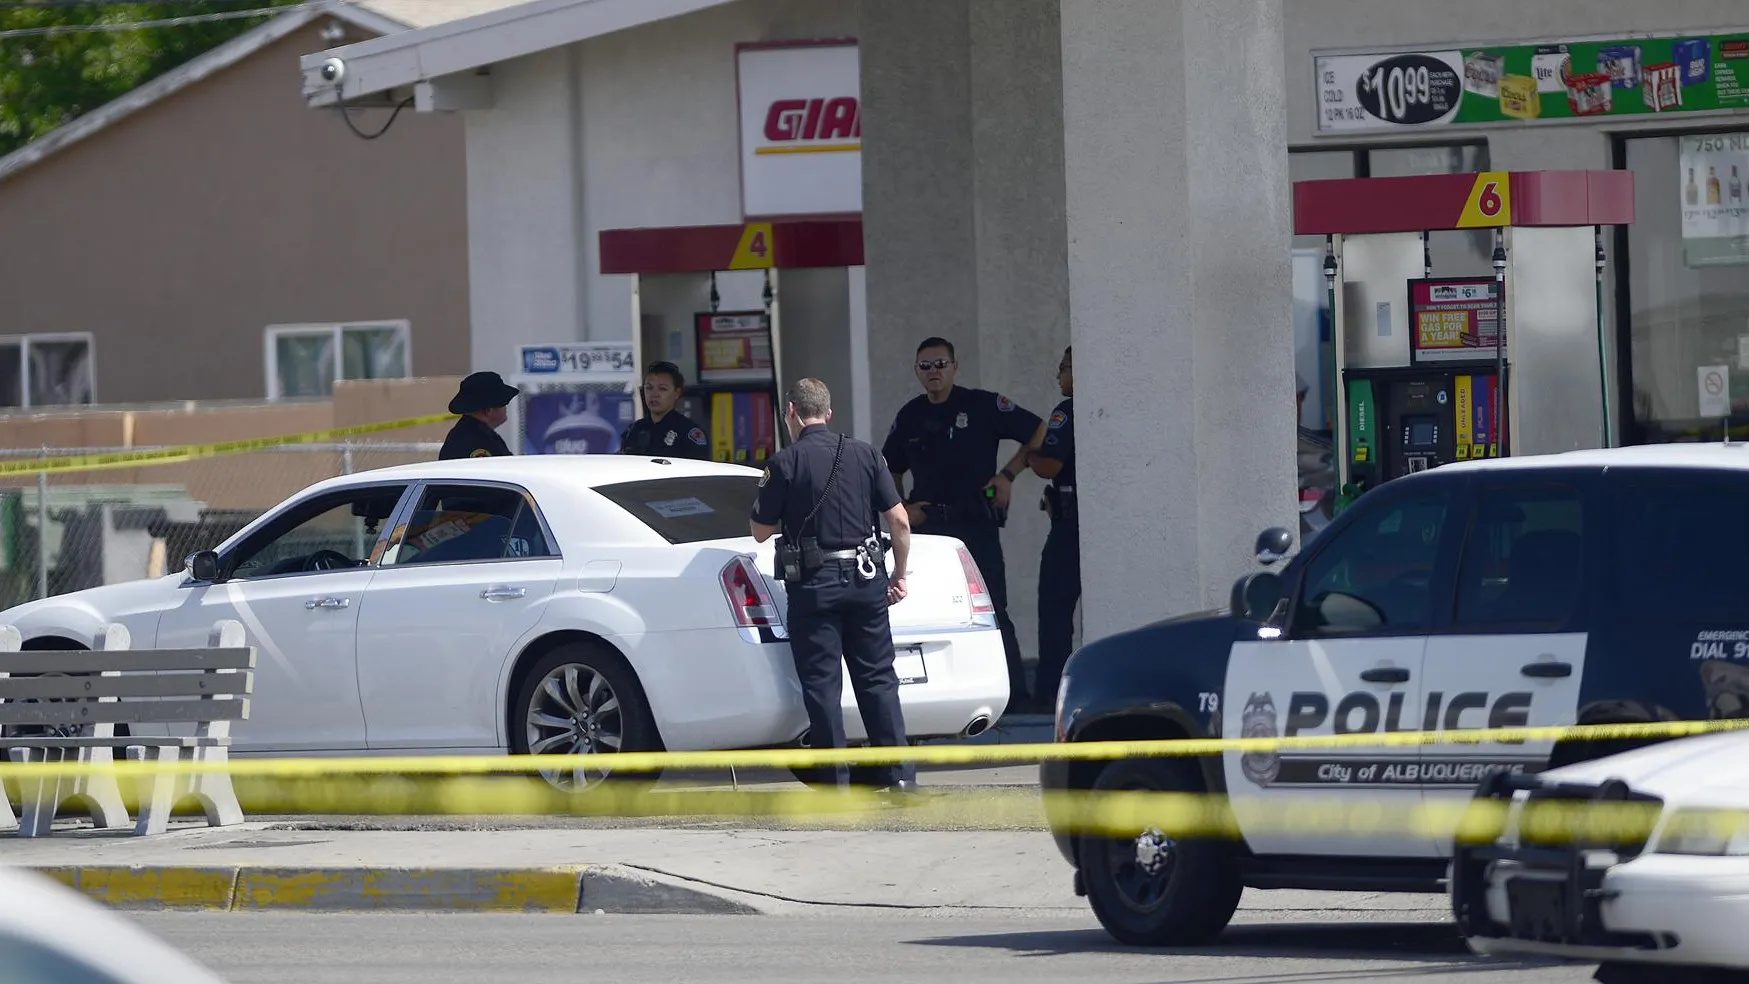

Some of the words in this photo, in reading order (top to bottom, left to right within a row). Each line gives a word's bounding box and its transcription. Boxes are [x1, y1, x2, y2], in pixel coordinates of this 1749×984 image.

[1536, 67, 1553, 80] Lite
[764, 97, 861, 141] GIA
[1696, 139, 1724, 152] 750
[1479, 181, 1502, 217] 6
[750, 230, 768, 259] 4
[1420, 314, 1439, 322] WIN
[1442, 312, 1466, 321] FREE
[1421, 323, 1441, 331] GAS
[1443, 322, 1462, 331] FOR
[1422, 333, 1428, 342] A
[1431, 331, 1459, 341] YEAR!
[1690, 642, 1727, 659] DIAL
[1198, 692, 1218, 712] T9
[1285, 691, 1535, 744] POLICE
[1317, 764, 1351, 782] City
[1358, 763, 1378, 780] of
